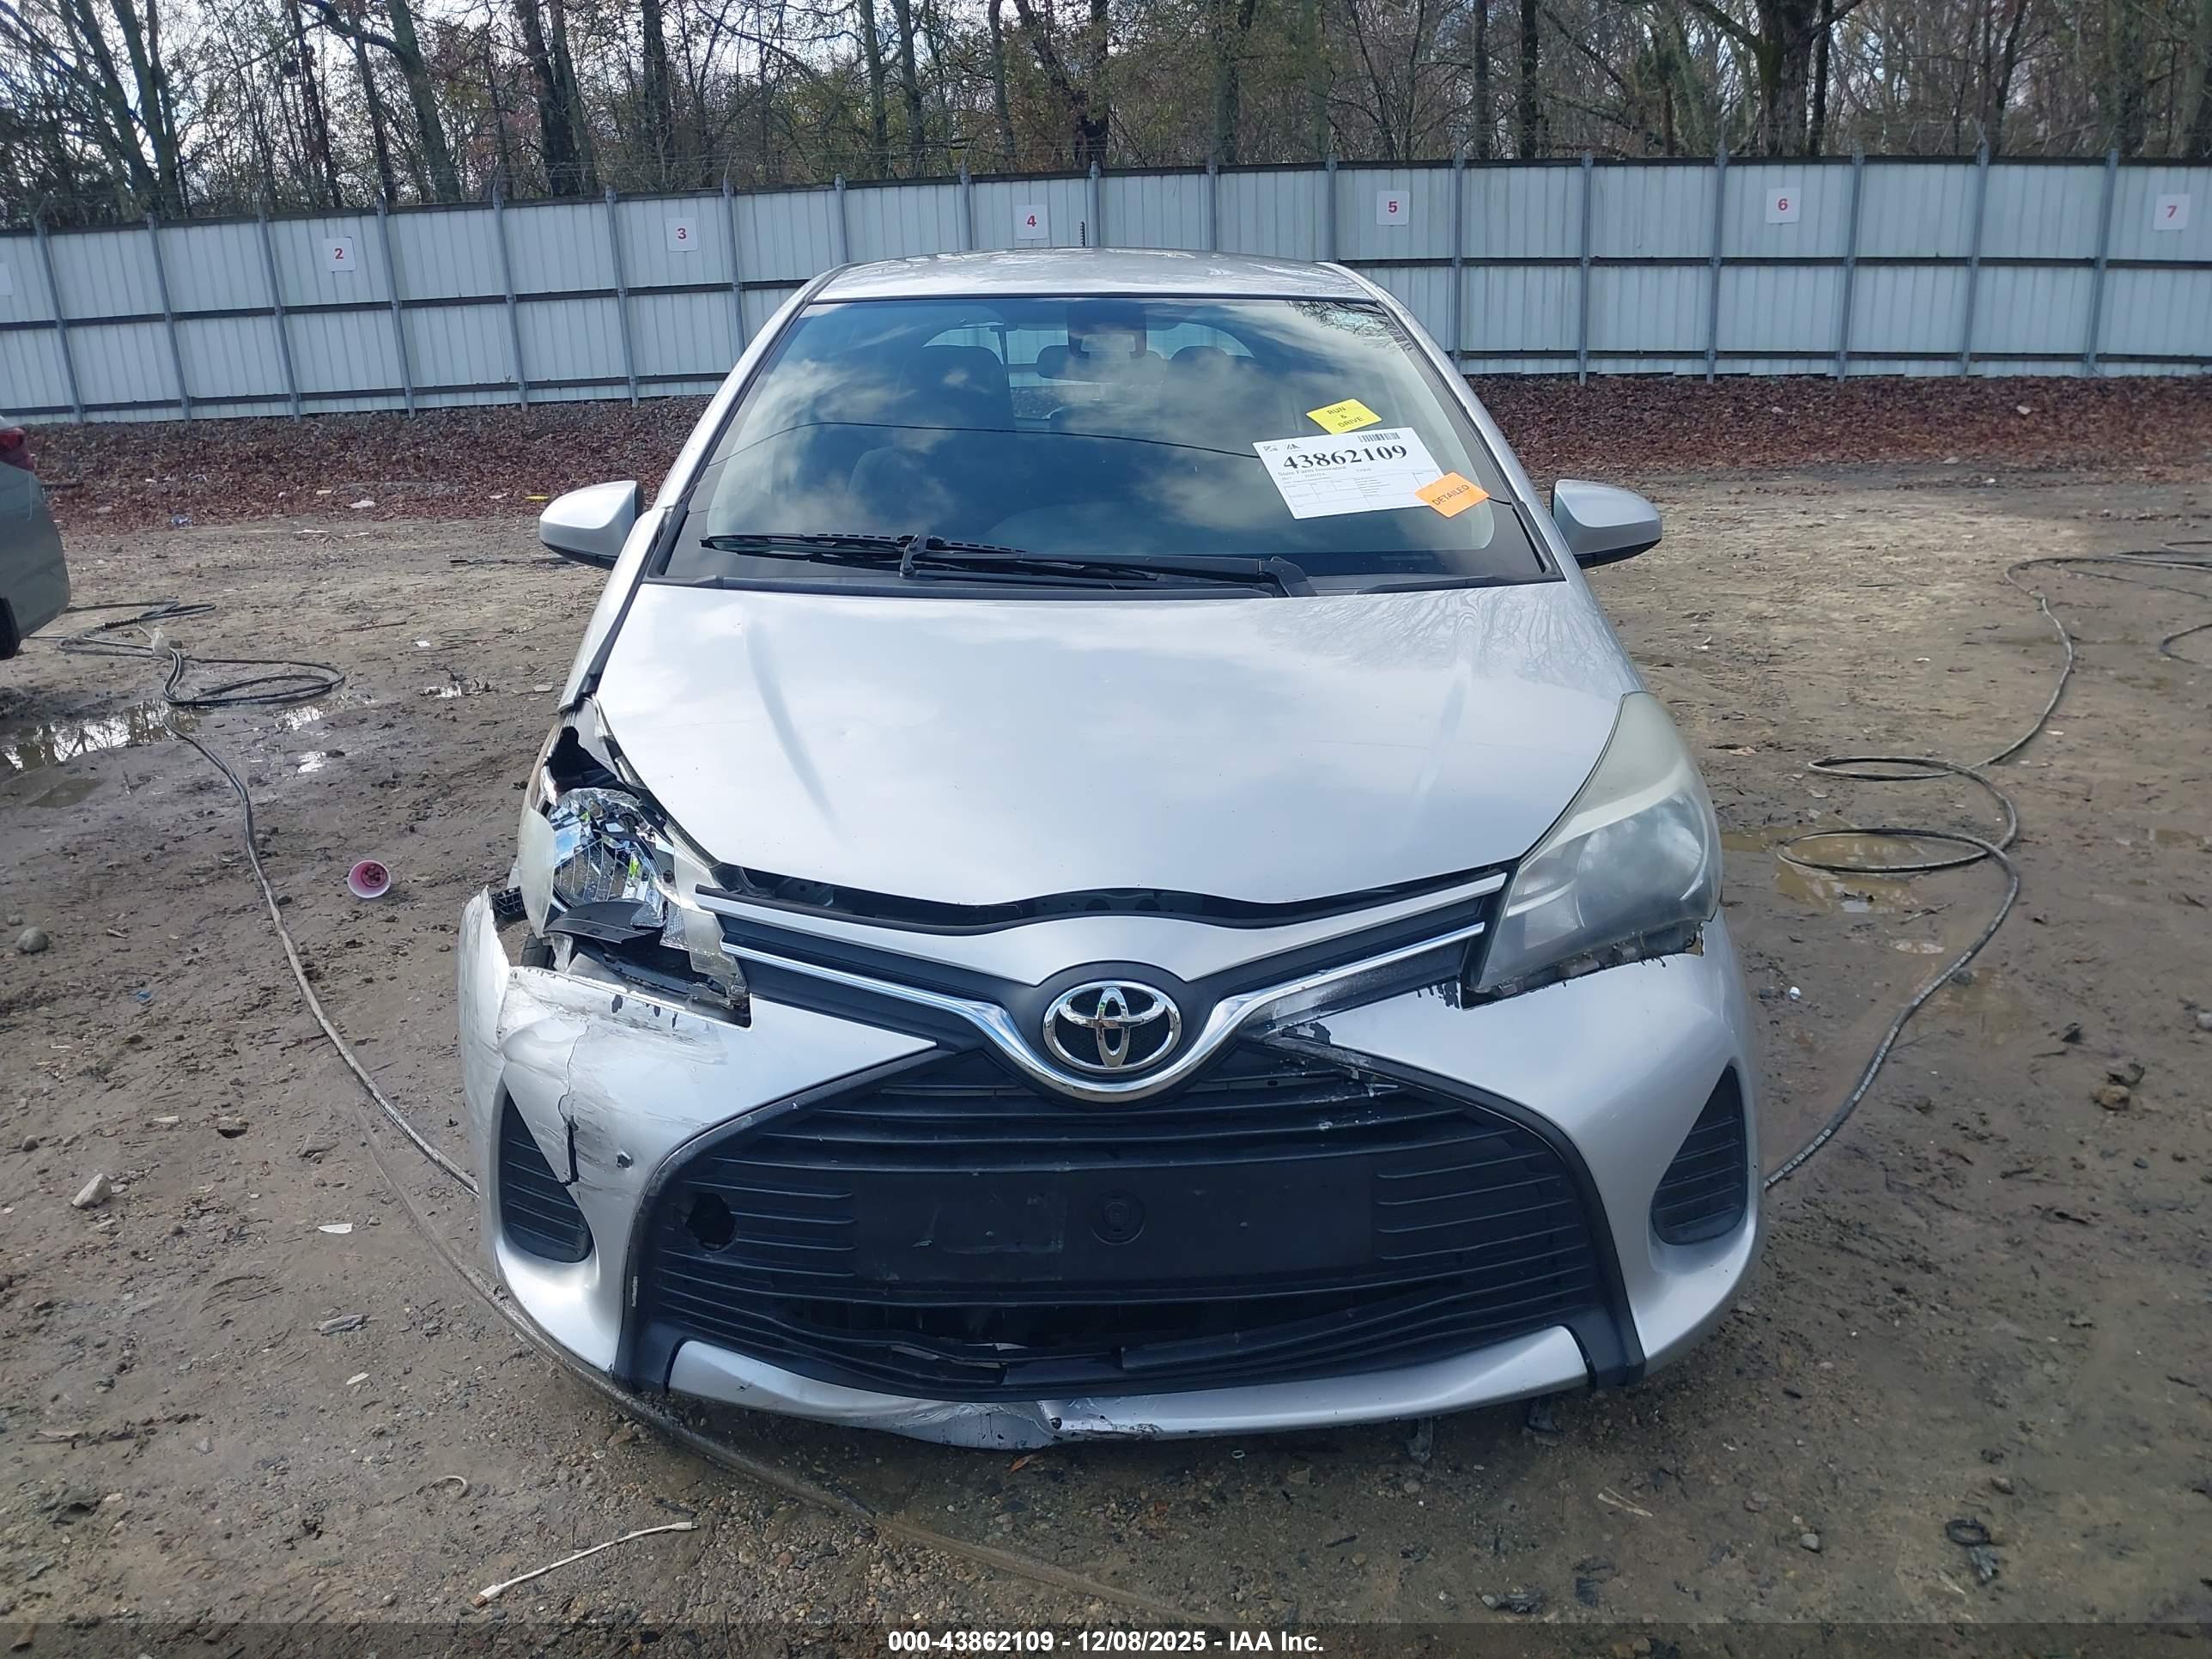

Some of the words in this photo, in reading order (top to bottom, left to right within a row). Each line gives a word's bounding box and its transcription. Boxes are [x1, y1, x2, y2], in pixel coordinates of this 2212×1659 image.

[1389, 201, 1398, 213] 5
[1778, 198, 1788, 210] 6
[2167, 205, 2178, 218] 7
[1027, 216, 1036, 227] 4
[678, 228, 687, 240] 3
[334, 248, 344, 259] 2
[1327, 405, 1346, 415] RUN
[1338, 416, 1364, 428] DRIVE
[1283, 445, 1407, 470] 43862109
